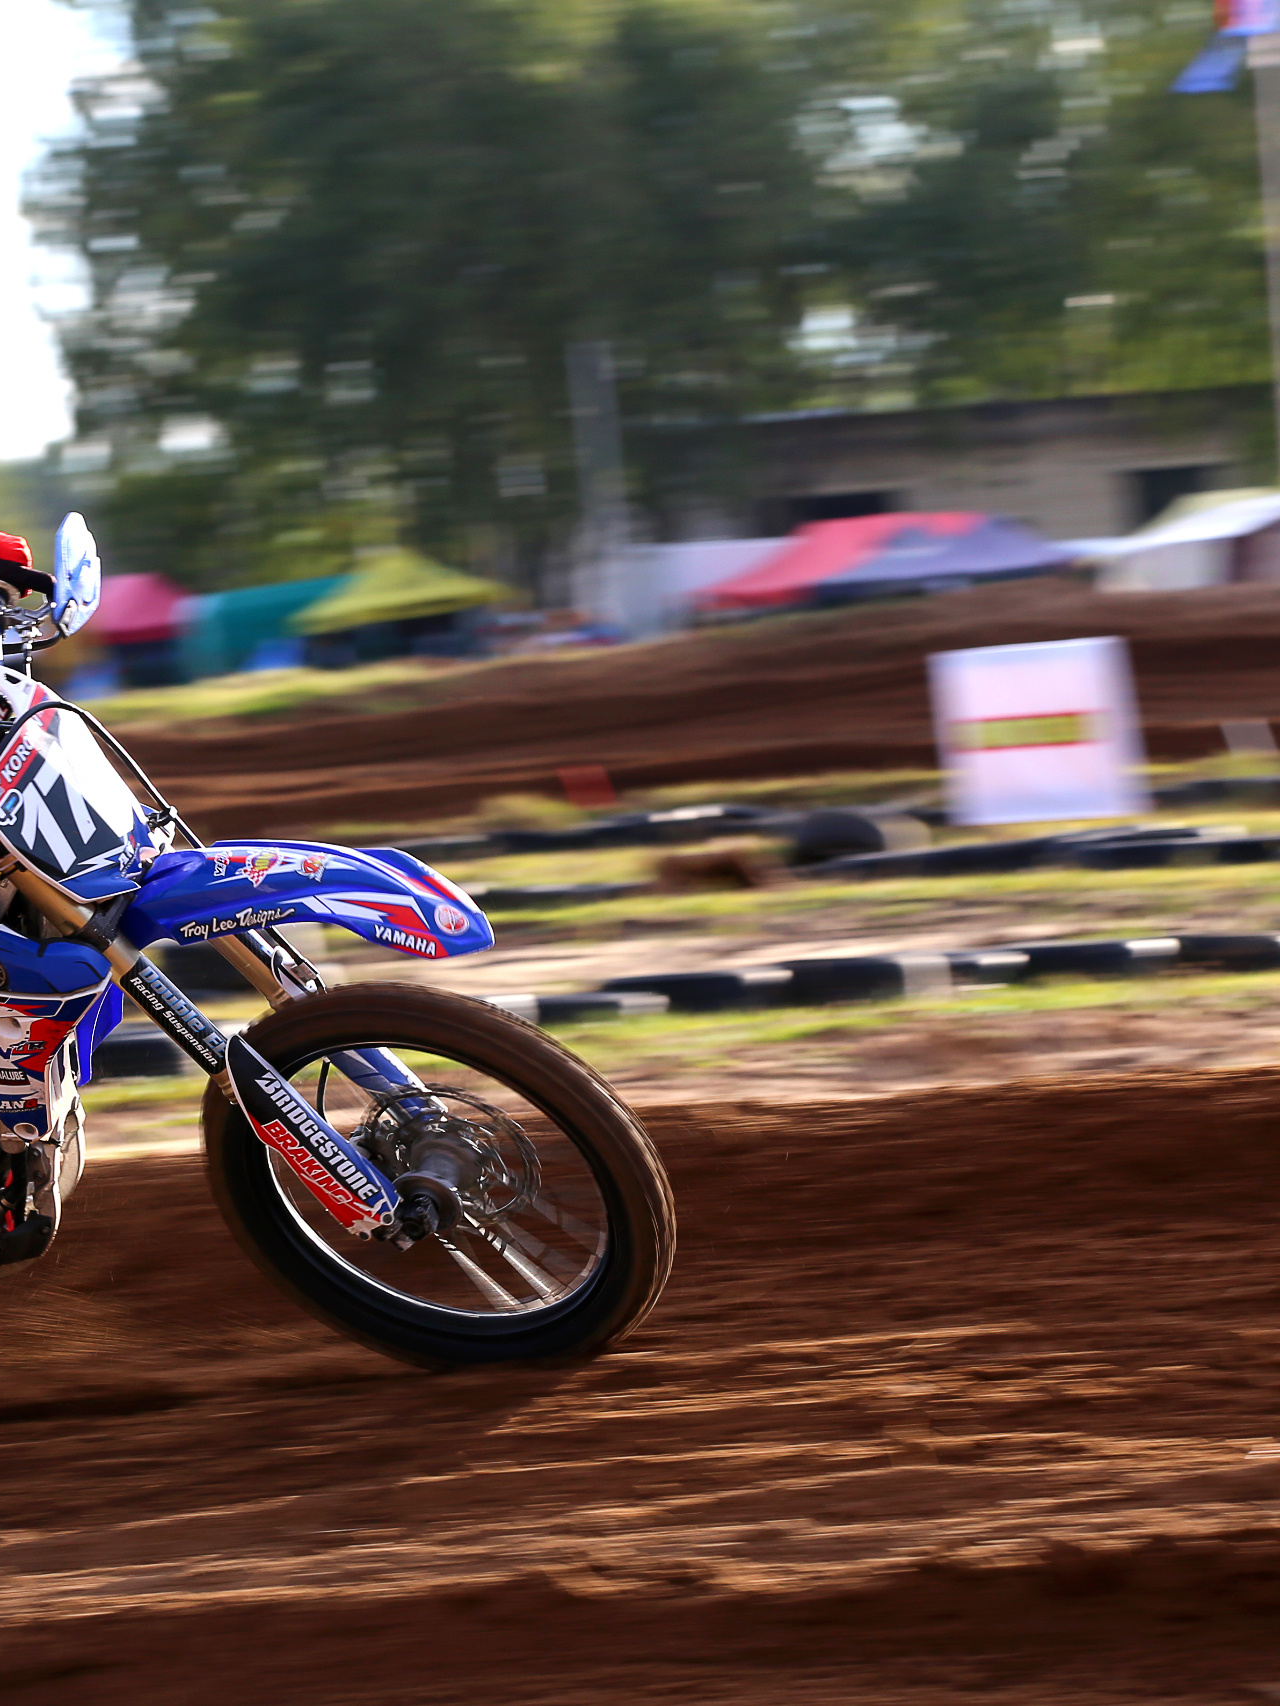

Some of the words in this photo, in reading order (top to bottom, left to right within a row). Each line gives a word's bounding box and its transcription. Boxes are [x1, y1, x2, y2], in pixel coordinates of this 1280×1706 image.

[179, 921, 209, 940] Troy
[212, 917, 237, 933] Lee
[235, 907, 295, 928] Designs
[373, 924, 437, 957] YAMAHA
[130, 976, 165, 1011] Racing
[138, 965, 206, 1033] Double
[255, 1073, 378, 1200] BRIDGESTONE
[262, 1119, 352, 1205] BRAKING
